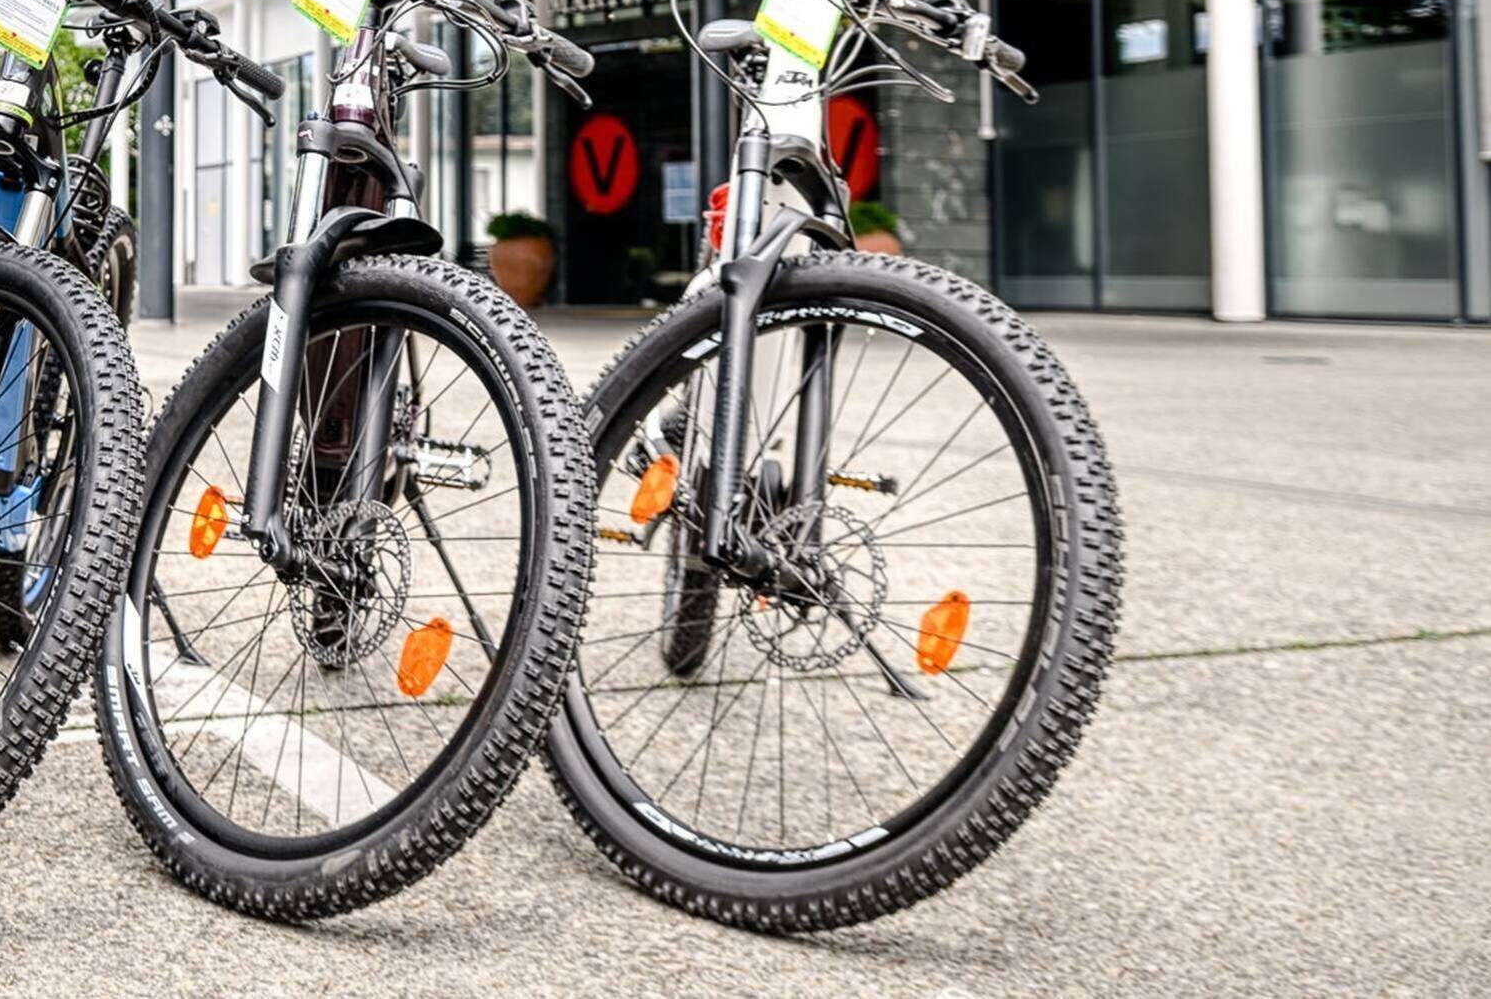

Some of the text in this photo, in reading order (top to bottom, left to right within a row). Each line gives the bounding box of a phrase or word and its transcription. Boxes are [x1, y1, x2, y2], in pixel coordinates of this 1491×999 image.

[581, 136, 626, 196] V
[106, 664, 141, 768] SMART
[136, 777, 179, 829] SAM
